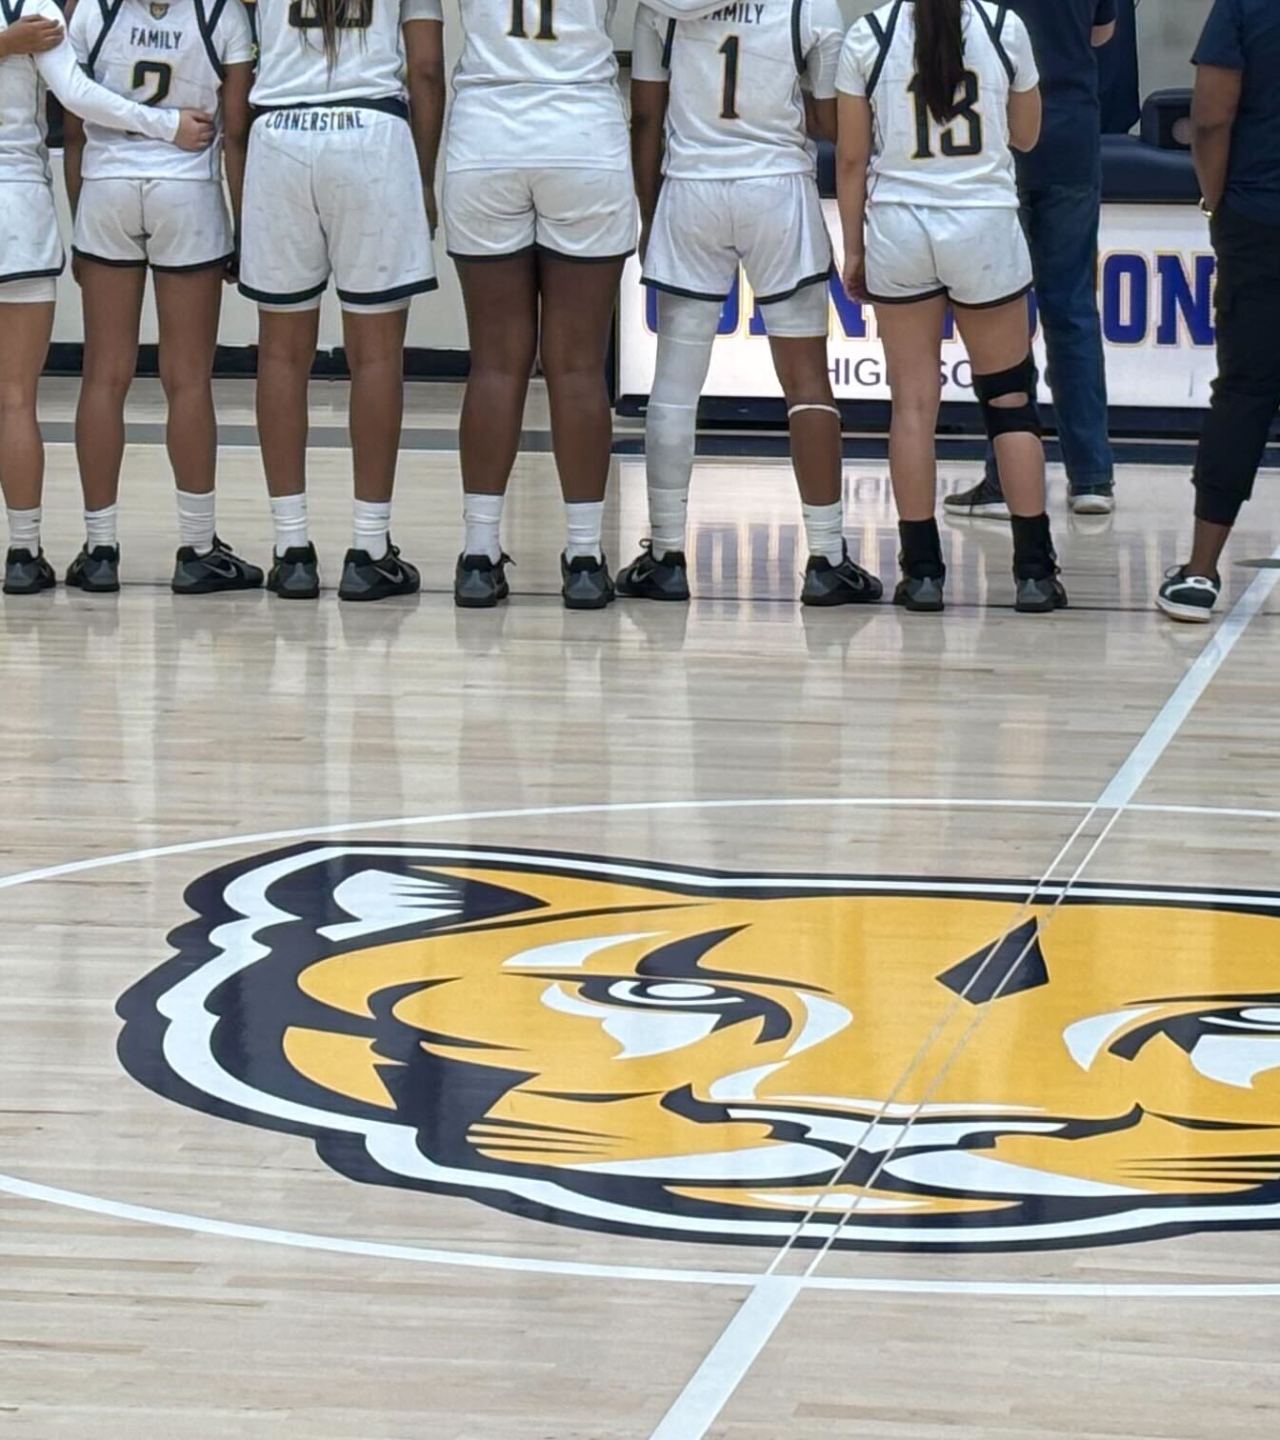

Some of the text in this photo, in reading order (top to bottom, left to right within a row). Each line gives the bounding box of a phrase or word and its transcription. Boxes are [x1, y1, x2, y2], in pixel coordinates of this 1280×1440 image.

[130, 26, 183, 50] FAMILY
[718, 35, 740, 120] 1
[265, 110, 365, 132] CORNERSTONE
[907, 70, 984, 160] 13
[828, 357, 888, 387] HIG
